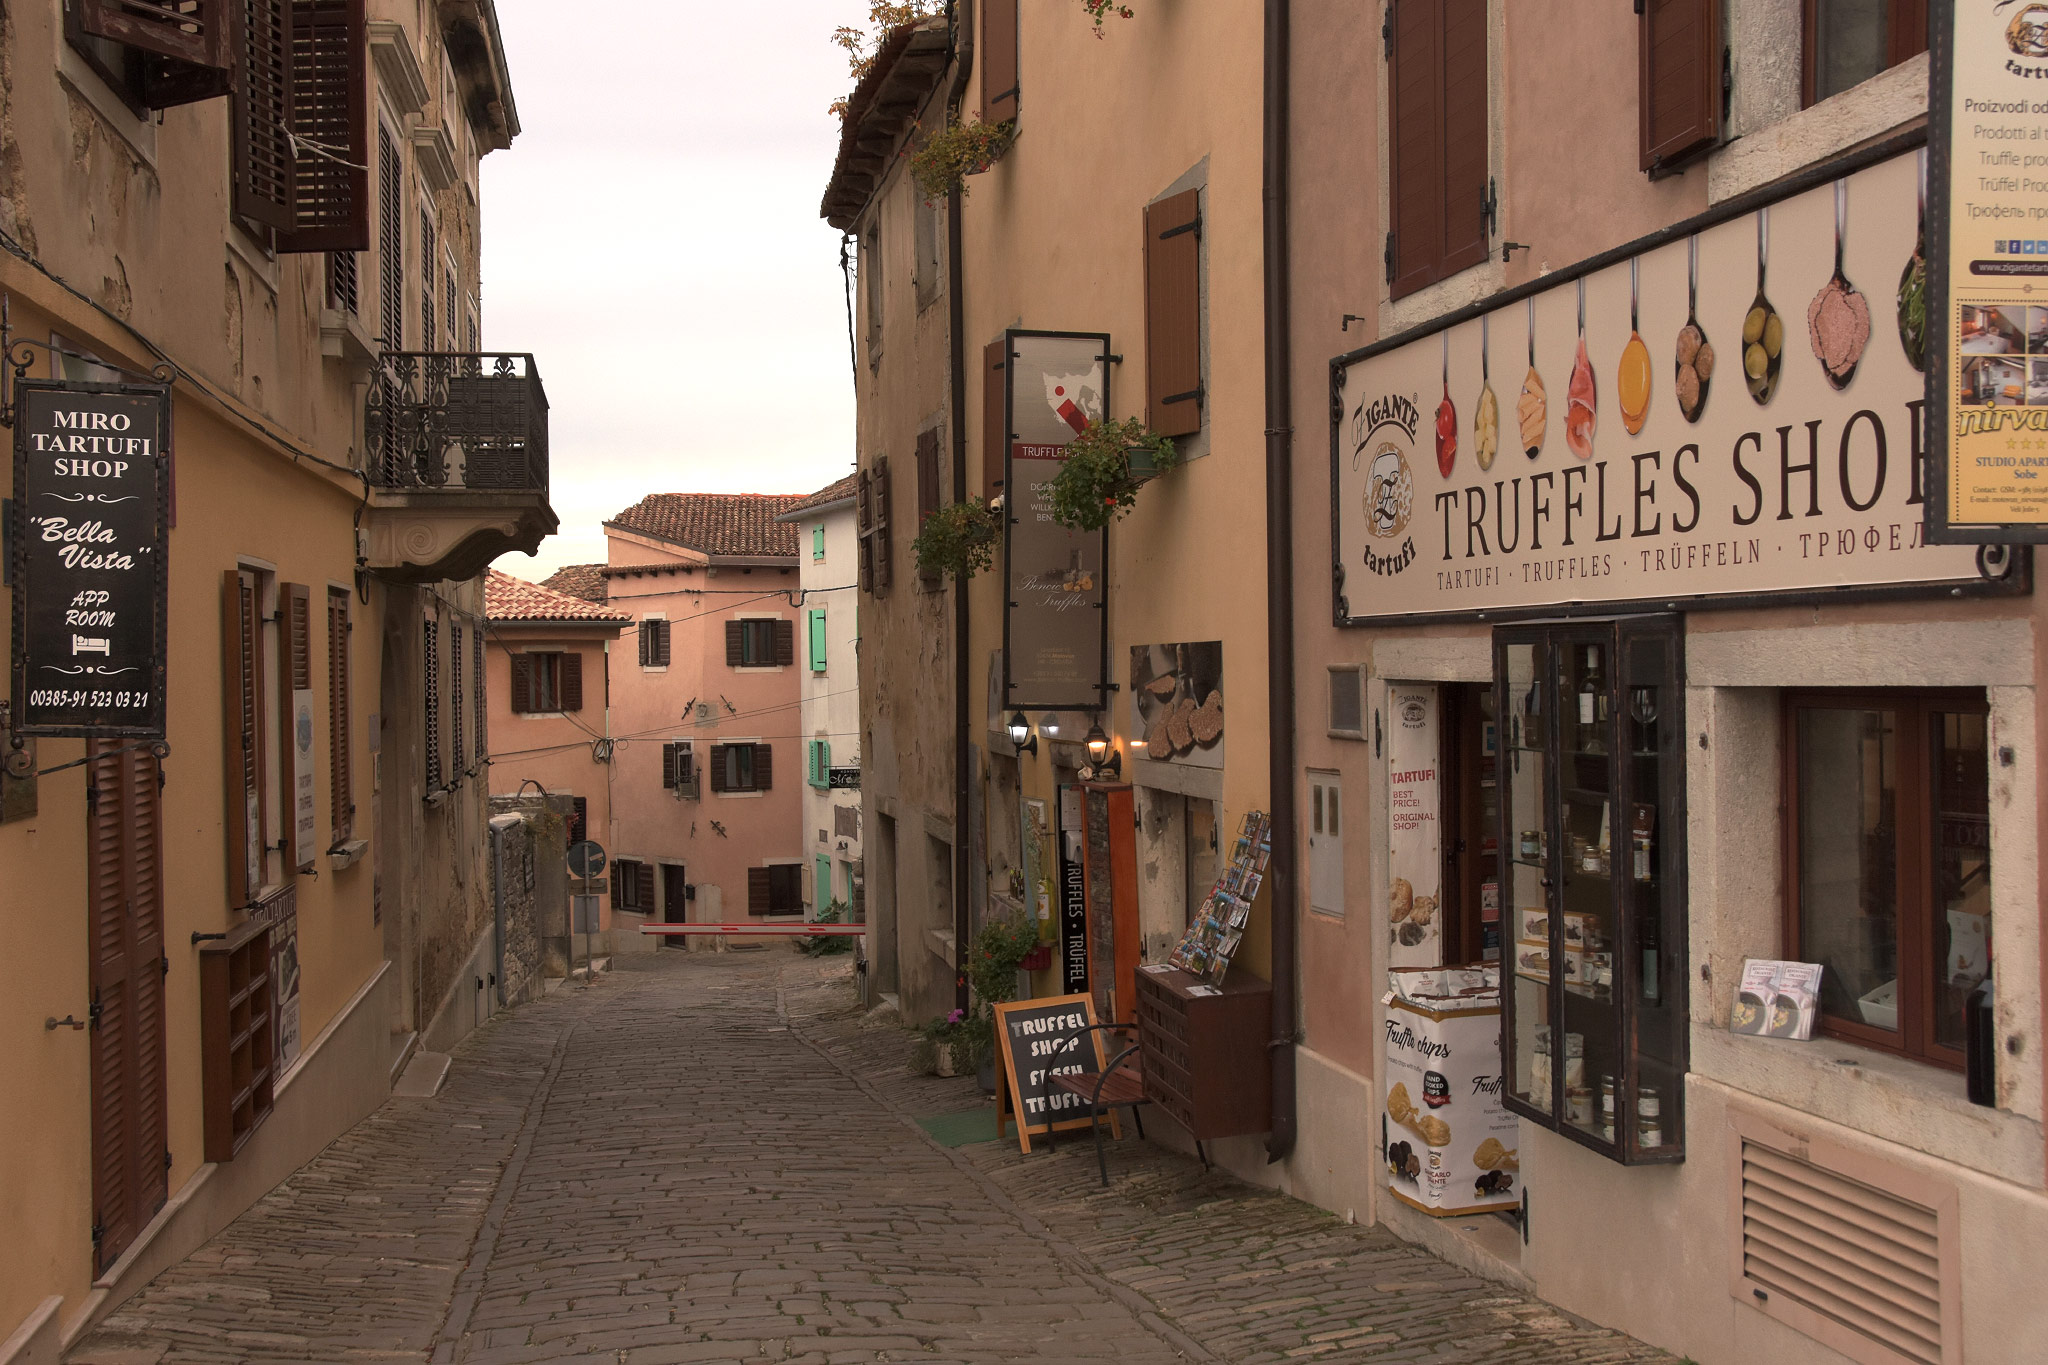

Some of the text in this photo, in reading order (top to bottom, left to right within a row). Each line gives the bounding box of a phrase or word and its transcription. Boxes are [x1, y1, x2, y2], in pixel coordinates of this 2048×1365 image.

[1965, 98, 2028, 113] Proizvodi
[1974, 125, 2026, 140] Prodotti
[2029, 125, 2041, 140] al
[1979, 151, 2020, 166] Truffle
[1978, 176, 2019, 192] Trüffel
[1965, 203, 2026, 220] Трюфель
[52, 410, 131, 431] MIRO
[31, 433, 152, 456] TARTUFI
[1022, 446, 1064, 457] TRUFFLE
[54, 458, 129, 478] SHOP
[1976, 456, 2016, 467] STUDIO
[2014, 469, 2038, 479] Sobe
[1436, 443, 1700, 560] TRUFFLES
[1799, 521, 1925, 558] ТРЮФЕЛ
[1363, 536, 1416, 576] tartufi
[1437, 538, 1760, 590] TARTUFI TRUFFLES TRÜFFELN
[70, 590, 110, 607] APP
[1036, 591, 1086, 612] Truffles
[65, 609, 116, 627] ROOM
[30, 689, 149, 708] 00385-91 523 03 21
[1391, 769, 1435, 784] TARTUFI
[1393, 790, 1413, 799] BEST
[1393, 799, 1420, 807] PRICE!
[1393, 812, 1435, 822] ORIGINAL
[1393, 822, 1419, 831] SHOP!
[1067, 863, 1086, 984] TRUFFLES TRÜFFEL
[1010, 1013, 1085, 1038] TRUFFEL
[1031, 1037, 1079, 1057] SHOP
[1385, 1019, 1452, 1059] Truffle chips
